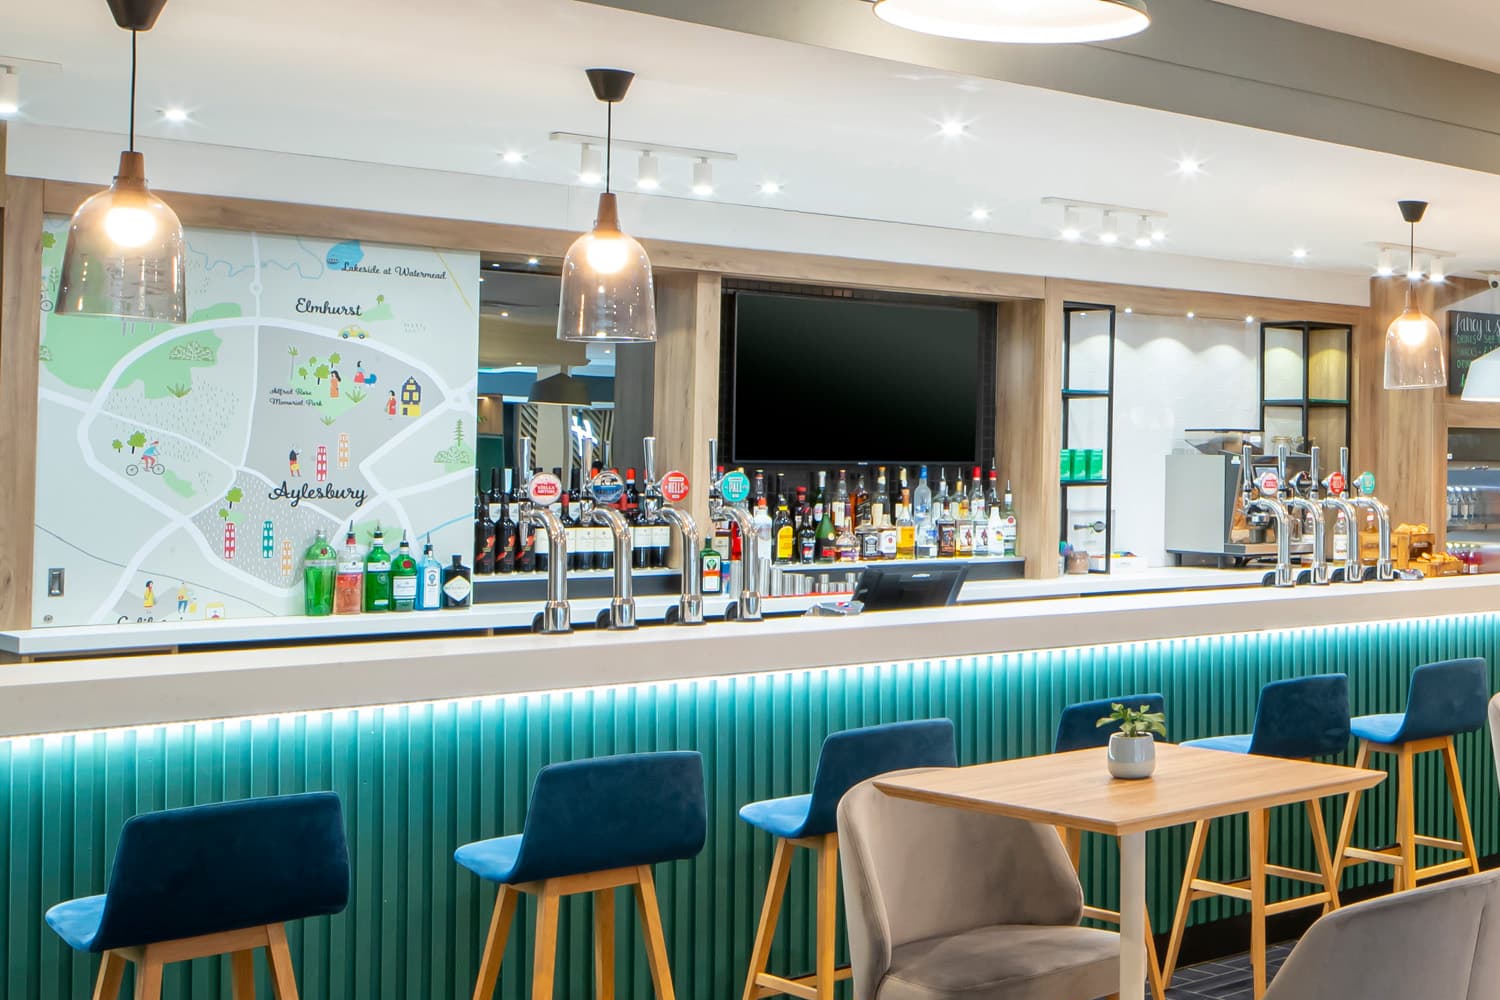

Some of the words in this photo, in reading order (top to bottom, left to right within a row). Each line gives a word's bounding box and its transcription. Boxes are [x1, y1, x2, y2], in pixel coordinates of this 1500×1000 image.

[341, 261, 380, 274] Lakeside
[383, 267, 392, 275] at
[394, 266, 447, 279] Watermead
[295, 297, 362, 316] Elmhurst
[268, 480, 368, 508] Aylesbury
